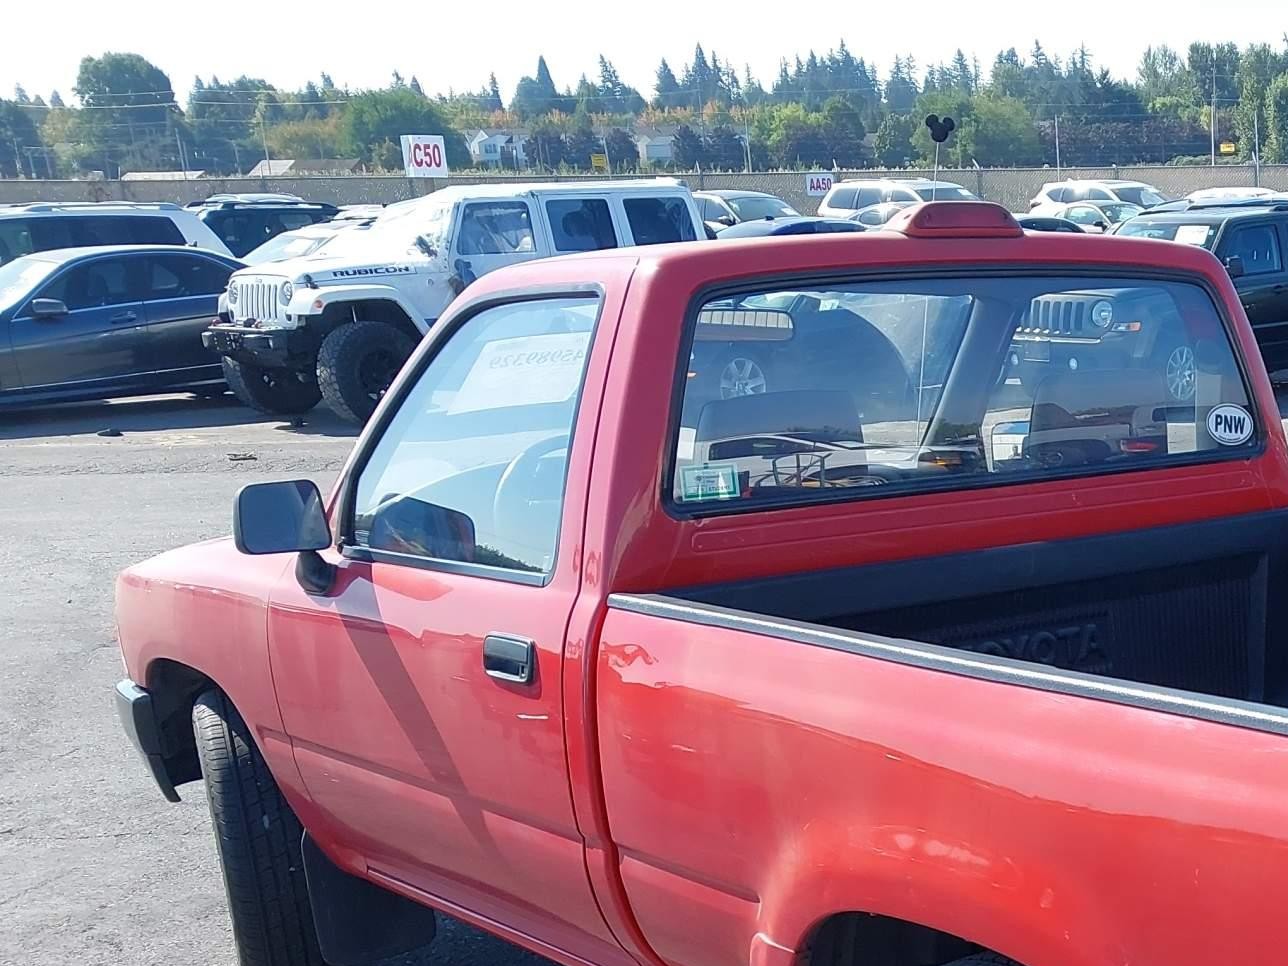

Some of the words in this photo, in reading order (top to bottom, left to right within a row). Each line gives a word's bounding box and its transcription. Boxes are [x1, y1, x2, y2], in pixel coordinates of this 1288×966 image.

[809, 177, 832, 191] AA50
[332, 266, 410, 278] RUBICON
[1214, 413, 1246, 435] PNW
